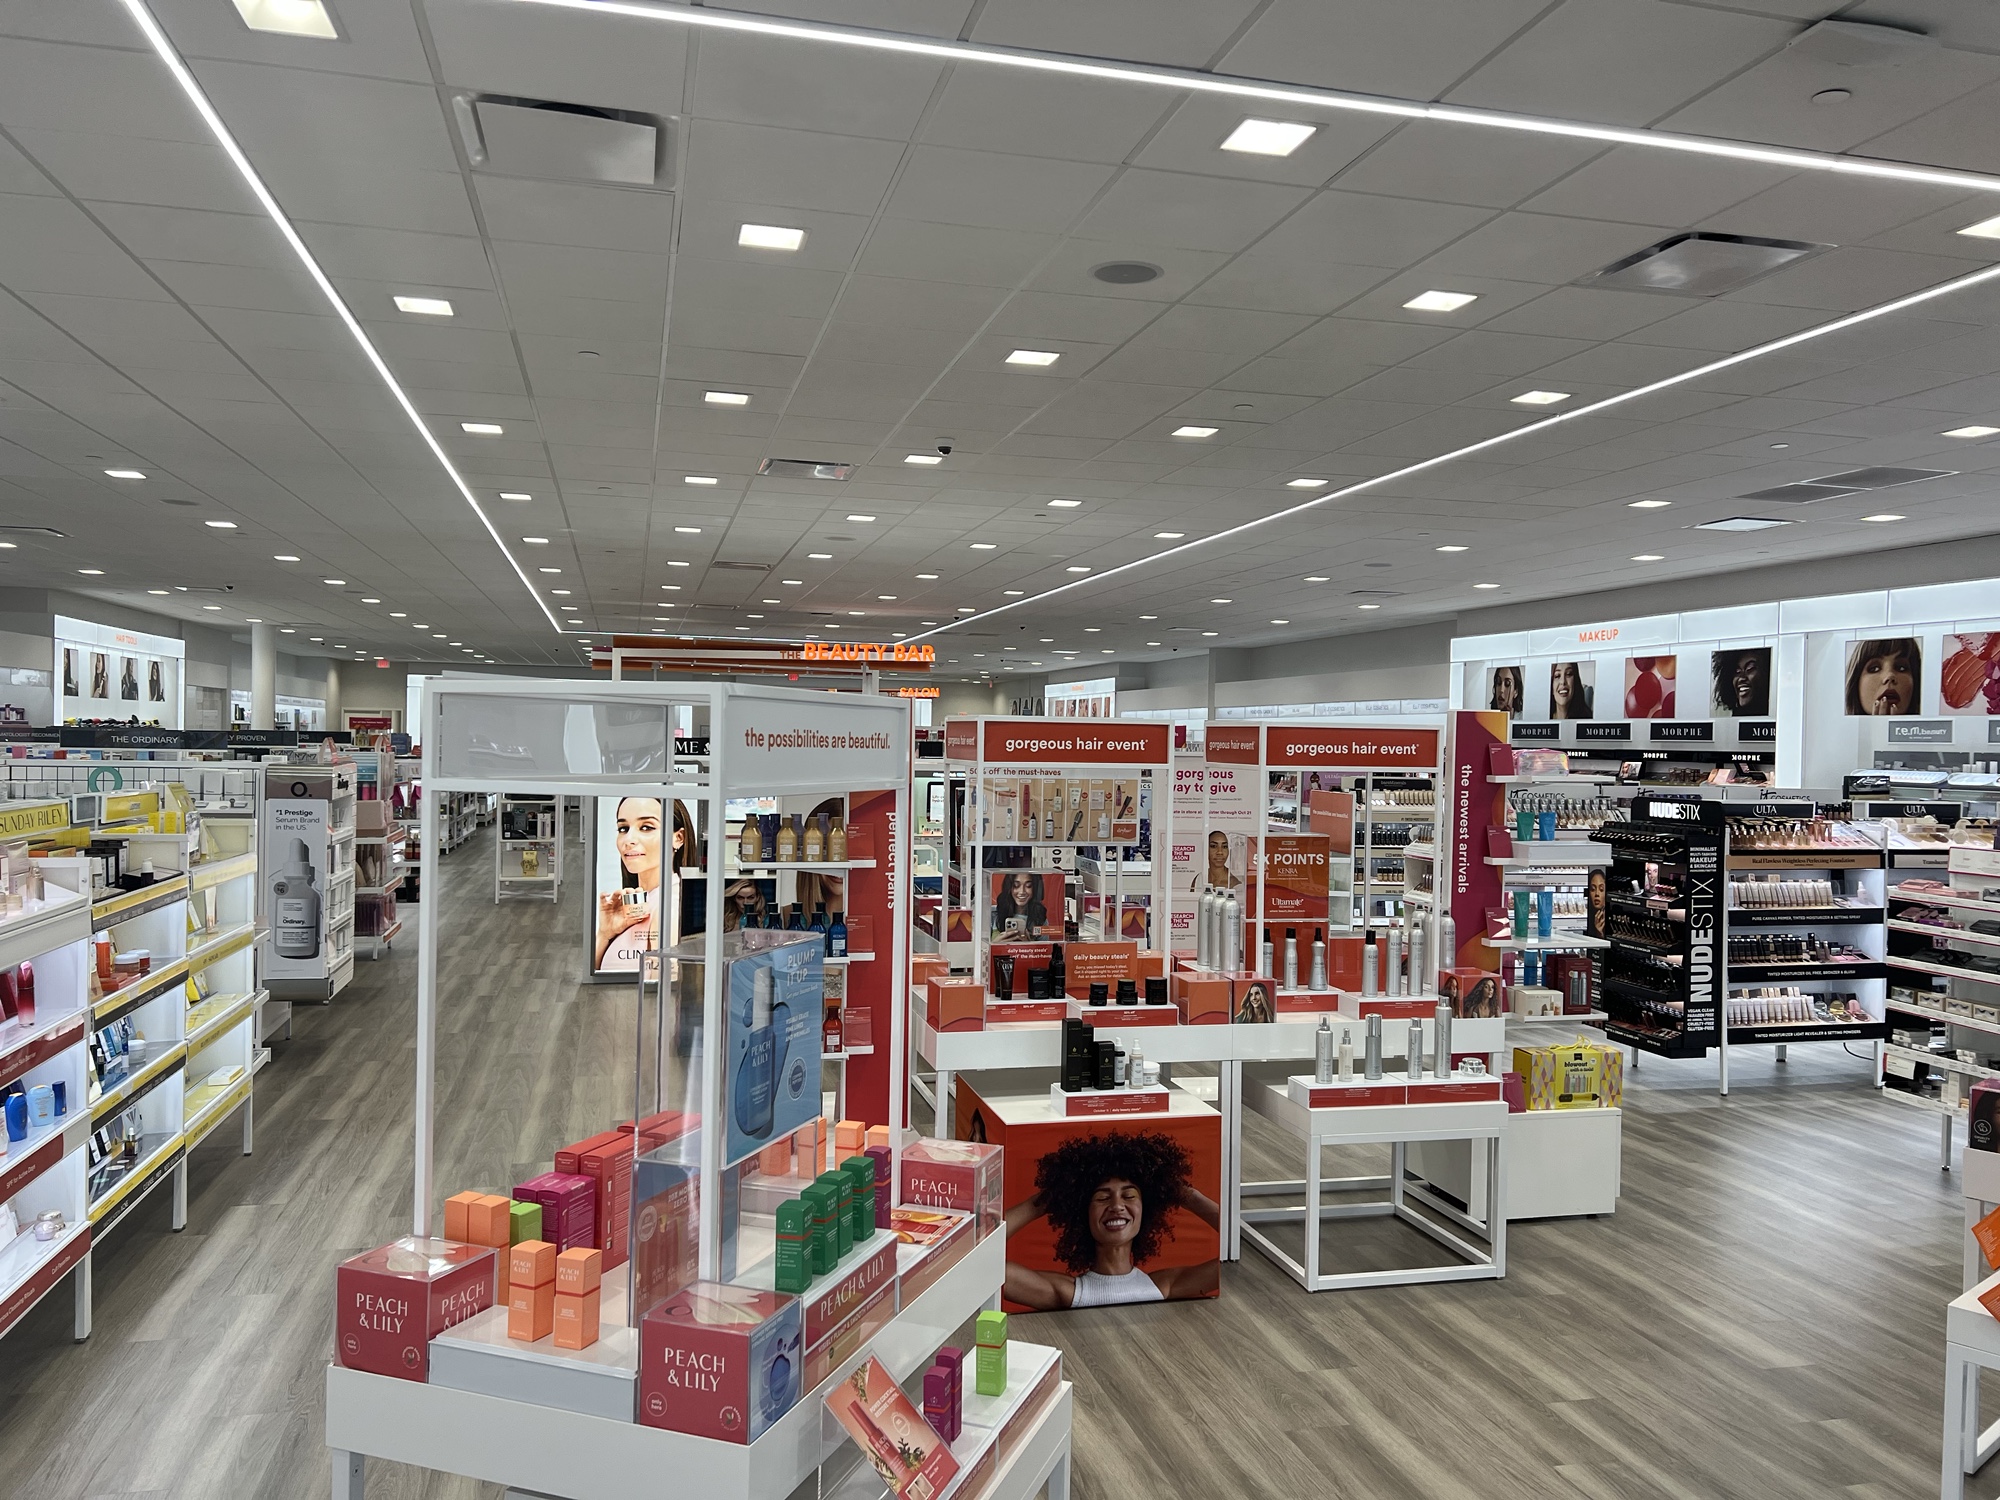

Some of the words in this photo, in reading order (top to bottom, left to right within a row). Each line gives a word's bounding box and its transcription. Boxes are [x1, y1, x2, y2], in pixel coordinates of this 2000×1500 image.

[115, 634, 125, 644] HAIR
[125, 635, 138, 646] TOOLS
[1579, 628, 1619, 643] MAKEUP
[780, 650, 801, 660] THE
[804, 643, 888, 661] BEAUTY
[894, 643, 935, 662] BAR
[900, 687, 940, 698] SALON
[236, 734, 267, 742] PROVEN
[1521, 728, 1552, 736] MORPHE
[1586, 728, 1622, 736] MORPHE
[1661, 727, 1703, 736] MORPHE
[1752, 727, 1776, 737] MOR
[111, 735, 129, 743] THE
[131, 735, 179, 744] ORDINARY
[744, 727, 764, 747] the
[767, 729, 830, 752] possibilities
[831, 734, 846, 749] are
[848, 732, 891, 750] beautiful.
[1005, 738, 1073, 753] gorgeous
[1076, 737, 1103, 751] hair
[1208, 741, 1230, 751] gorgeous
[1230, 739, 1240, 750] hair
[1286, 743, 1349, 757] gorgeous
[1352, 742, 1378, 755] hair
[1003, 767, 1016, 776] the
[1018, 767, 1062, 776] must-haves
[1460, 764, 1473, 787] the
[1210, 782, 1237, 795] give
[284, 809, 314, 817] Prestige
[1459, 790, 1470, 840] newest
[1649, 801, 1701, 821] NUDESTIX
[1755, 805, 1777, 814] ULTA
[1906, 805, 1927, 814] ULTA
[0, 813, 35, 833] SUNDAY
[37, 808, 62, 827] RILEY
[275, 816, 299, 824] Serum
[299, 816, 320, 824] Brand
[1273, 853, 1325, 866] POINTS
[1277, 867, 1298, 875] KENRA
[1457, 842, 1470, 894] arrivals
[1690, 878, 1714, 1003] NUDESTIX
[787, 948, 816, 968] PLUMP
[1089, 953, 1110, 961] beauty
[796, 968, 808, 983] UP
[751, 1040, 771, 1057] PEACH
[757, 1053, 768, 1066] LILY
[911, 1178, 958, 1196] PEACH
[512, 1260, 532, 1268] PEACH
[559, 1267, 580, 1276] PEACH
[820, 1277, 857, 1322] PEACH
[858, 1272, 866, 1289] &
[867, 1252, 886, 1283] LILY
[356, 1292, 408, 1317] PEACH
[441, 1280, 485, 1316] PEACH
[359, 1312, 370, 1330] &
[373, 1313, 404, 1334] LILY
[664, 1347, 726, 1374] PEACH
[667, 1369, 680, 1388] &
[685, 1370, 721, 1393] LILY
[651, 1398, 663, 1406] only
[651, 1403, 663, 1411] here
